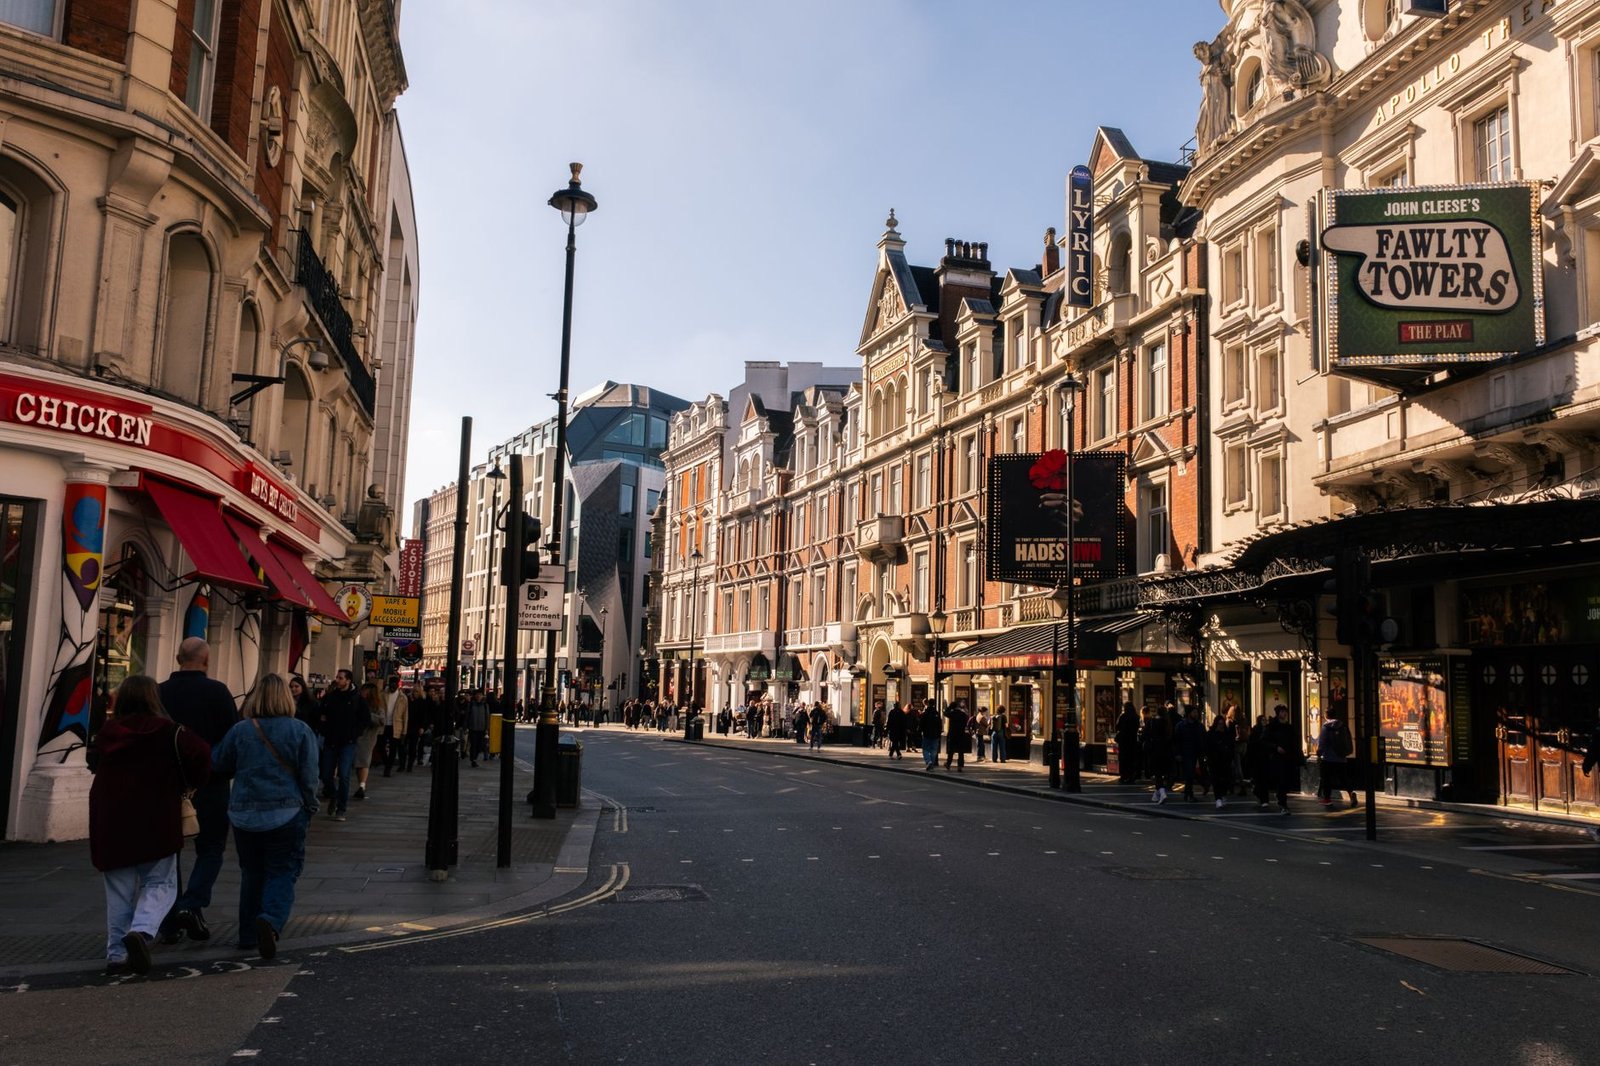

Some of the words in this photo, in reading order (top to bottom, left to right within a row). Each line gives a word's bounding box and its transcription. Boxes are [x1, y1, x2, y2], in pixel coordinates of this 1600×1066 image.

[1376, 53, 1460, 126] APOLLO
[1384, 200, 1418, 217] JOHN
[1422, 198, 1480, 215] CLEESE'S
[1071, 188, 1092, 296] LYRIC
[1375, 228, 1491, 260] FAWLTY
[1367, 261, 1510, 306] TOWERS
[1408, 324, 1432, 340] THE
[1435, 323, 1464, 338] PLAY
[15, 392, 154, 447] CHICKEN
[1015, 542, 1102, 562] HADESOWN
[408, 547, 418, 593] COYOTE
[383, 608, 407, 616] MOBILE
[524, 603, 549, 612] Traffic
[373, 615, 415, 625] ACCESSORIES
[972, 659, 985, 669] BEST
[986, 658, 1002, 668] SHOW
[1003, 657, 1010, 667] IN
